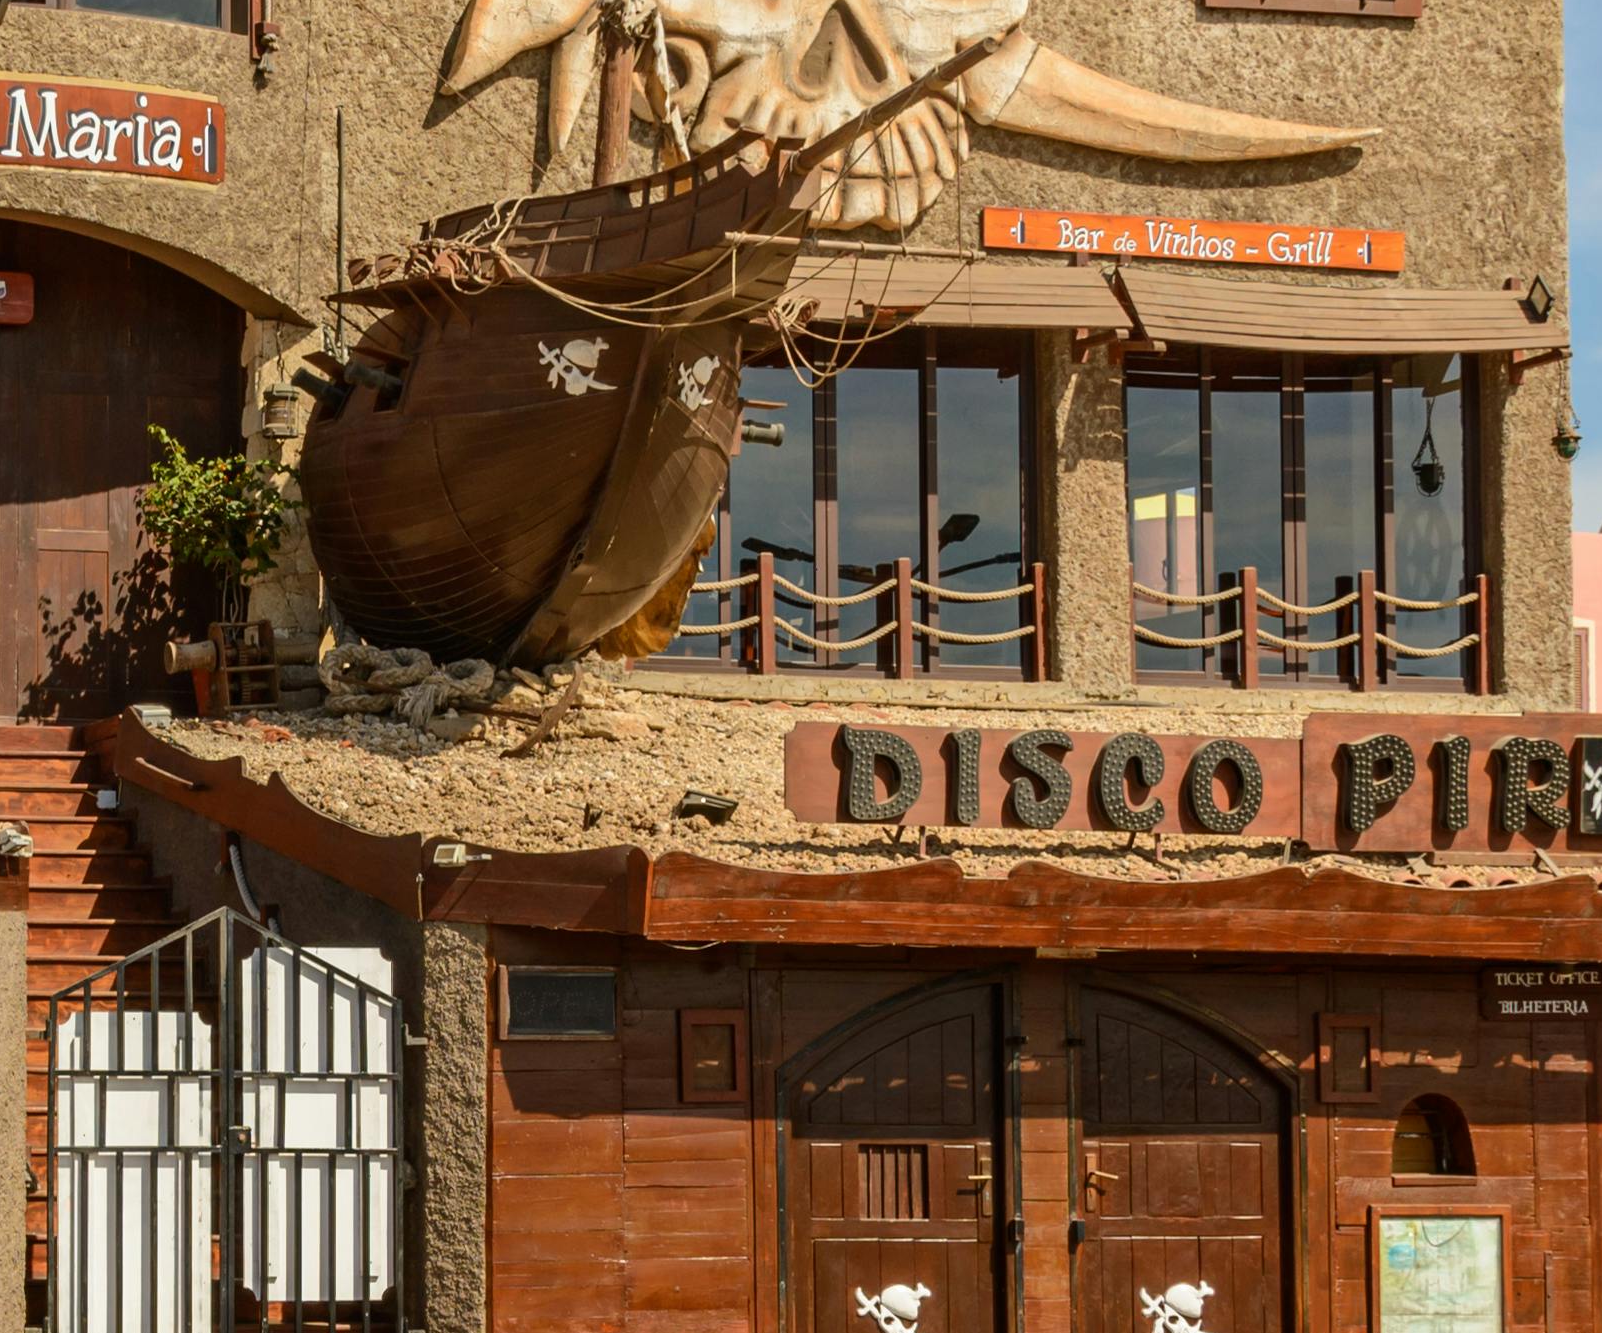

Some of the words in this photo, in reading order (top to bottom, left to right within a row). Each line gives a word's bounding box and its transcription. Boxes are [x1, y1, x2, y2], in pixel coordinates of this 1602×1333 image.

[1057, 218, 1105, 251] Bar
[1112, 230, 1138, 252] de
[1144, 220, 1237, 260] Vinhos
[1266, 231, 1334, 265] Grill
[839, 723, 1264, 833] DISCO
[1494, 971, 1544, 987] TICKET
[1549, 970, 1602, 986] OFFICE
[1498, 999, 1589, 1016] BILHETERIA
